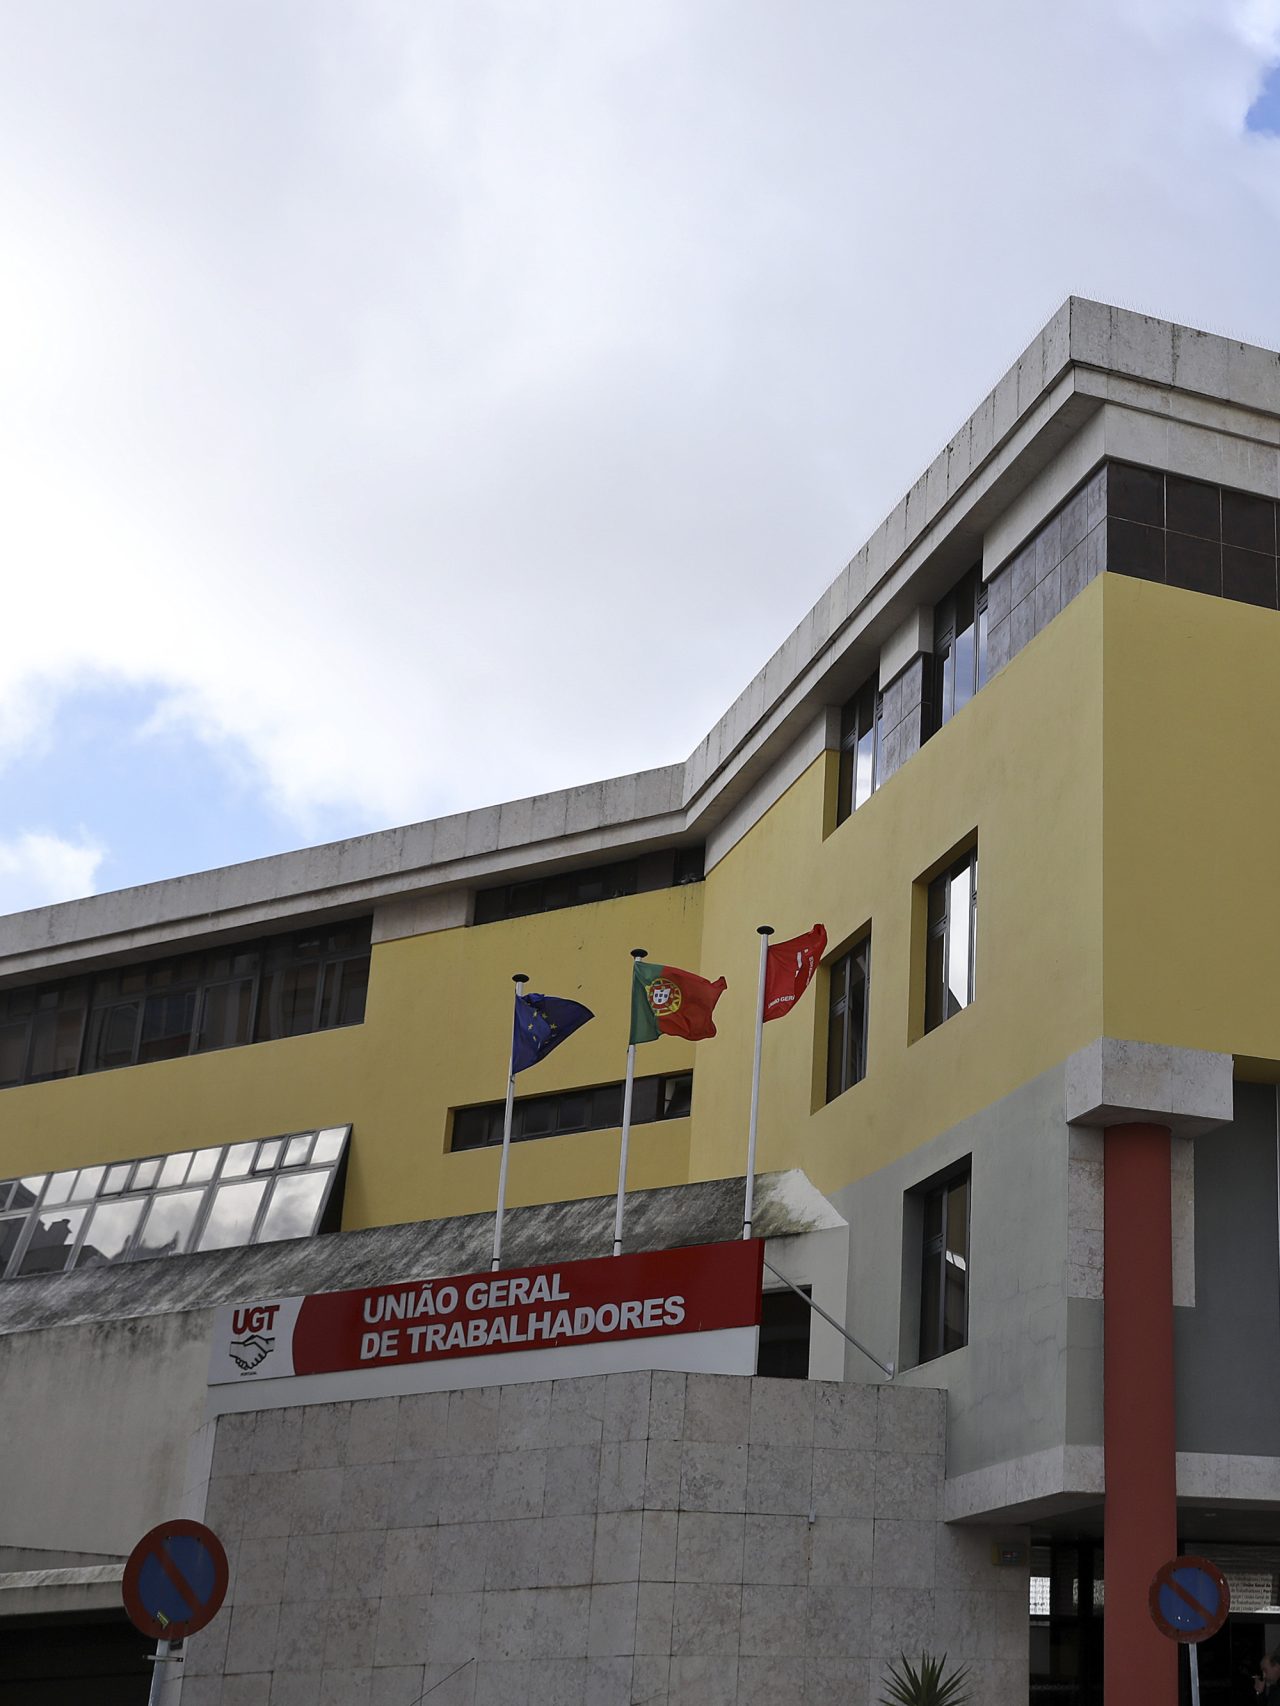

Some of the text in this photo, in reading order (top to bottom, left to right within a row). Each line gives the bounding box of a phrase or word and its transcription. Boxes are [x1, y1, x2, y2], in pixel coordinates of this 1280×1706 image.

[232, 1304, 280, 1335] UGT
[363, 1273, 570, 1324] UNIÃO GERAL
[360, 1295, 685, 1360] DE TRABALHADORES
